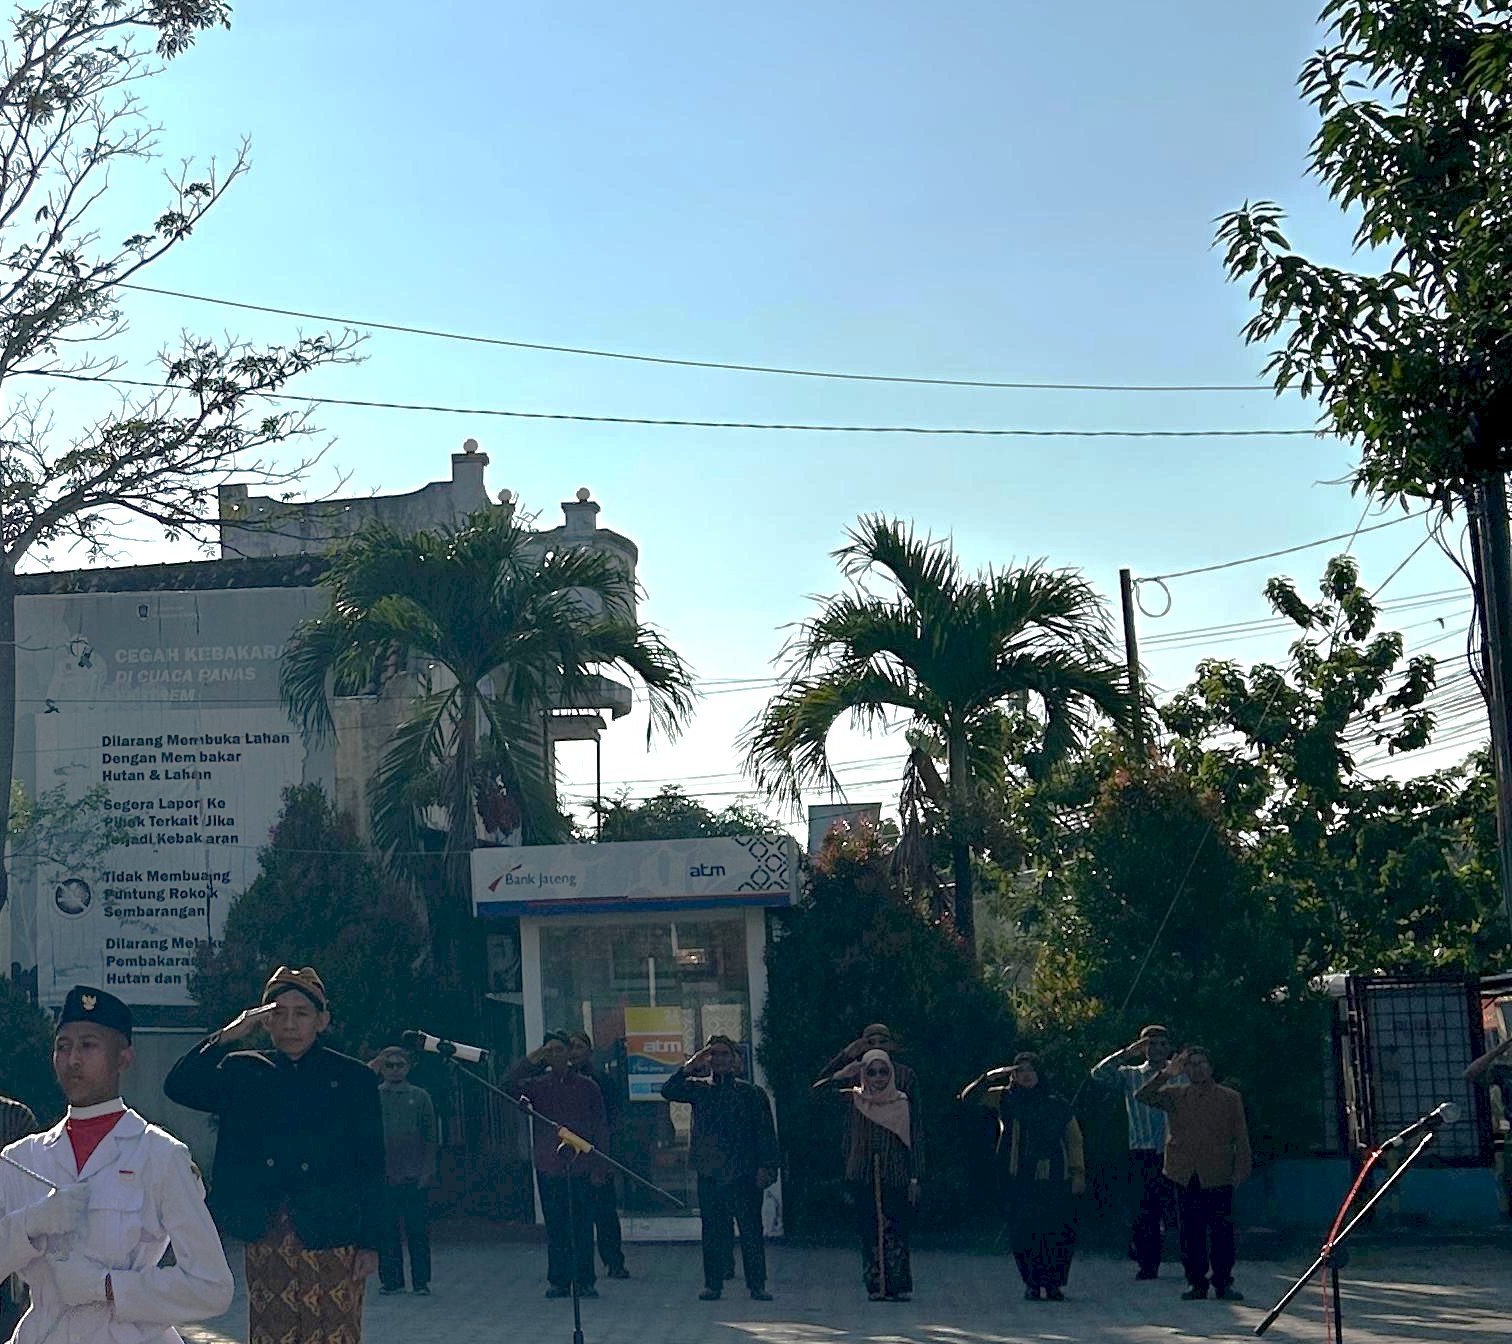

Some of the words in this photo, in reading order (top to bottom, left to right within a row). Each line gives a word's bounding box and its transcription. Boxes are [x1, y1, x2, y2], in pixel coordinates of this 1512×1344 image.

[115, 648, 179, 664] CEGAH
[185, 645, 282, 663] KEBAKAR
[115, 670, 132, 683] DI
[139, 669, 193, 683] CUACA
[198, 667, 256, 682] PANAS
[102, 735, 163, 748] Dilarang
[167, 733, 240, 746] Membuka
[245, 732, 290, 744] Lahan
[102, 753, 156, 766] Dengan
[102, 770, 145, 782] Hutan
[149, 770, 160, 780] &
[165, 769, 211, 780] Lahan
[104, 799, 154, 812] Segera
[159, 798, 200, 811] Lapor
[207, 798, 226, 808] Ke
[149, 815, 199, 827] Terkait
[205, 815, 235, 827] Jika
[103, 871, 143, 882] Tidak
[505, 873, 536, 886] Bank
[538, 873, 577, 888] Jateng
[689, 863, 726, 878] atm
[104, 888, 165, 902] Puntung
[169, 887, 218, 899] Rokok
[104, 906, 205, 919] Sembarangan
[106, 938, 168, 951] Dilarang
[106, 956, 195, 967] Pembakara
[107, 973, 150, 984] Hutan
[154, 972, 182, 984] dan
[643, 1039, 682, 1053] atm
